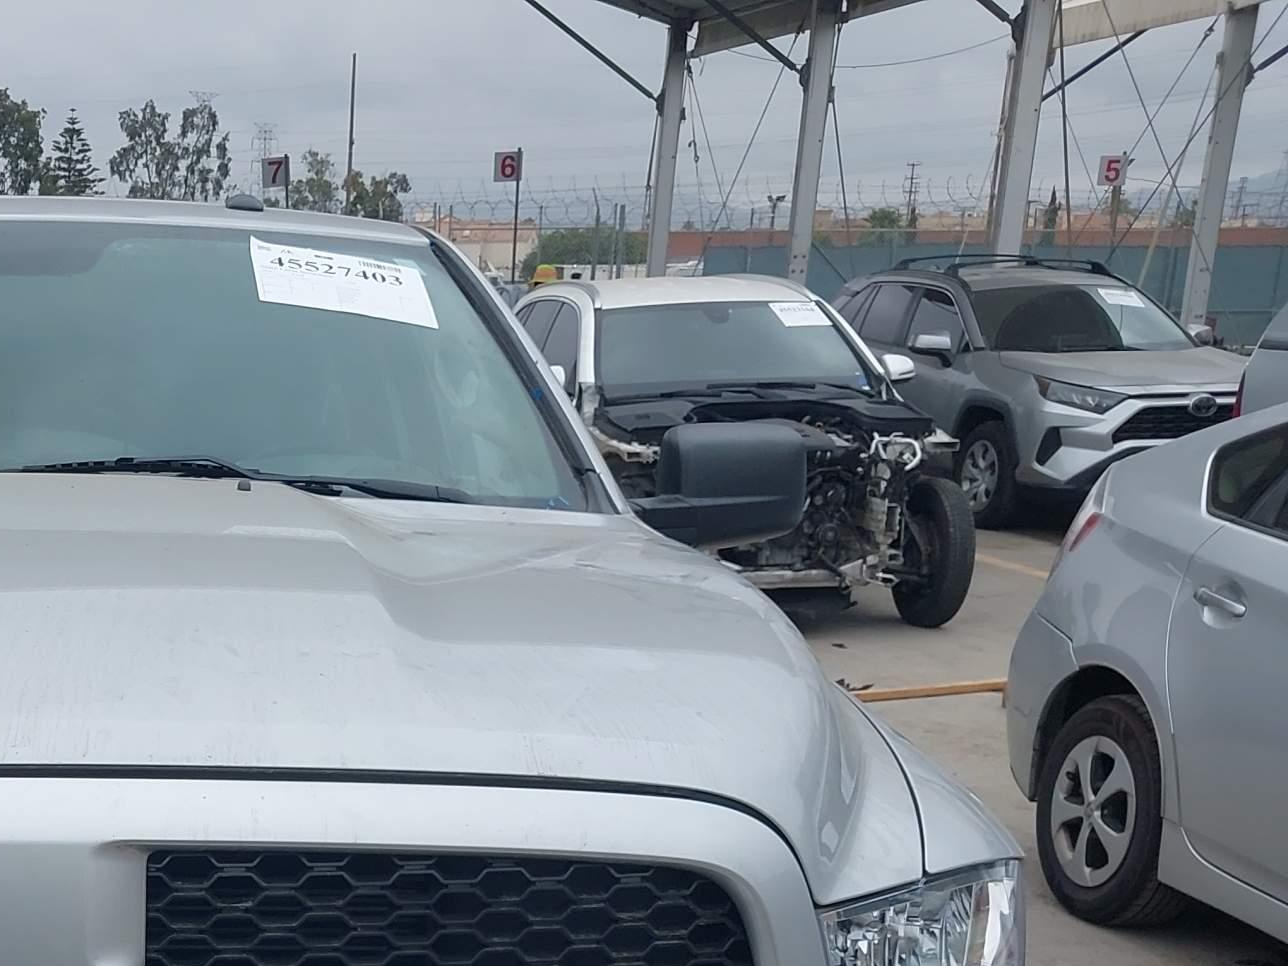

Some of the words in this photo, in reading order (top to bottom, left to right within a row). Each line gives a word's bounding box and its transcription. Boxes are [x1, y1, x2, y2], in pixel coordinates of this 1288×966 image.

[268, 160, 283, 184] 7
[501, 155, 516, 178] 6
[1104, 159, 1121, 183] 5
[269, 256, 404, 287] 45527403
